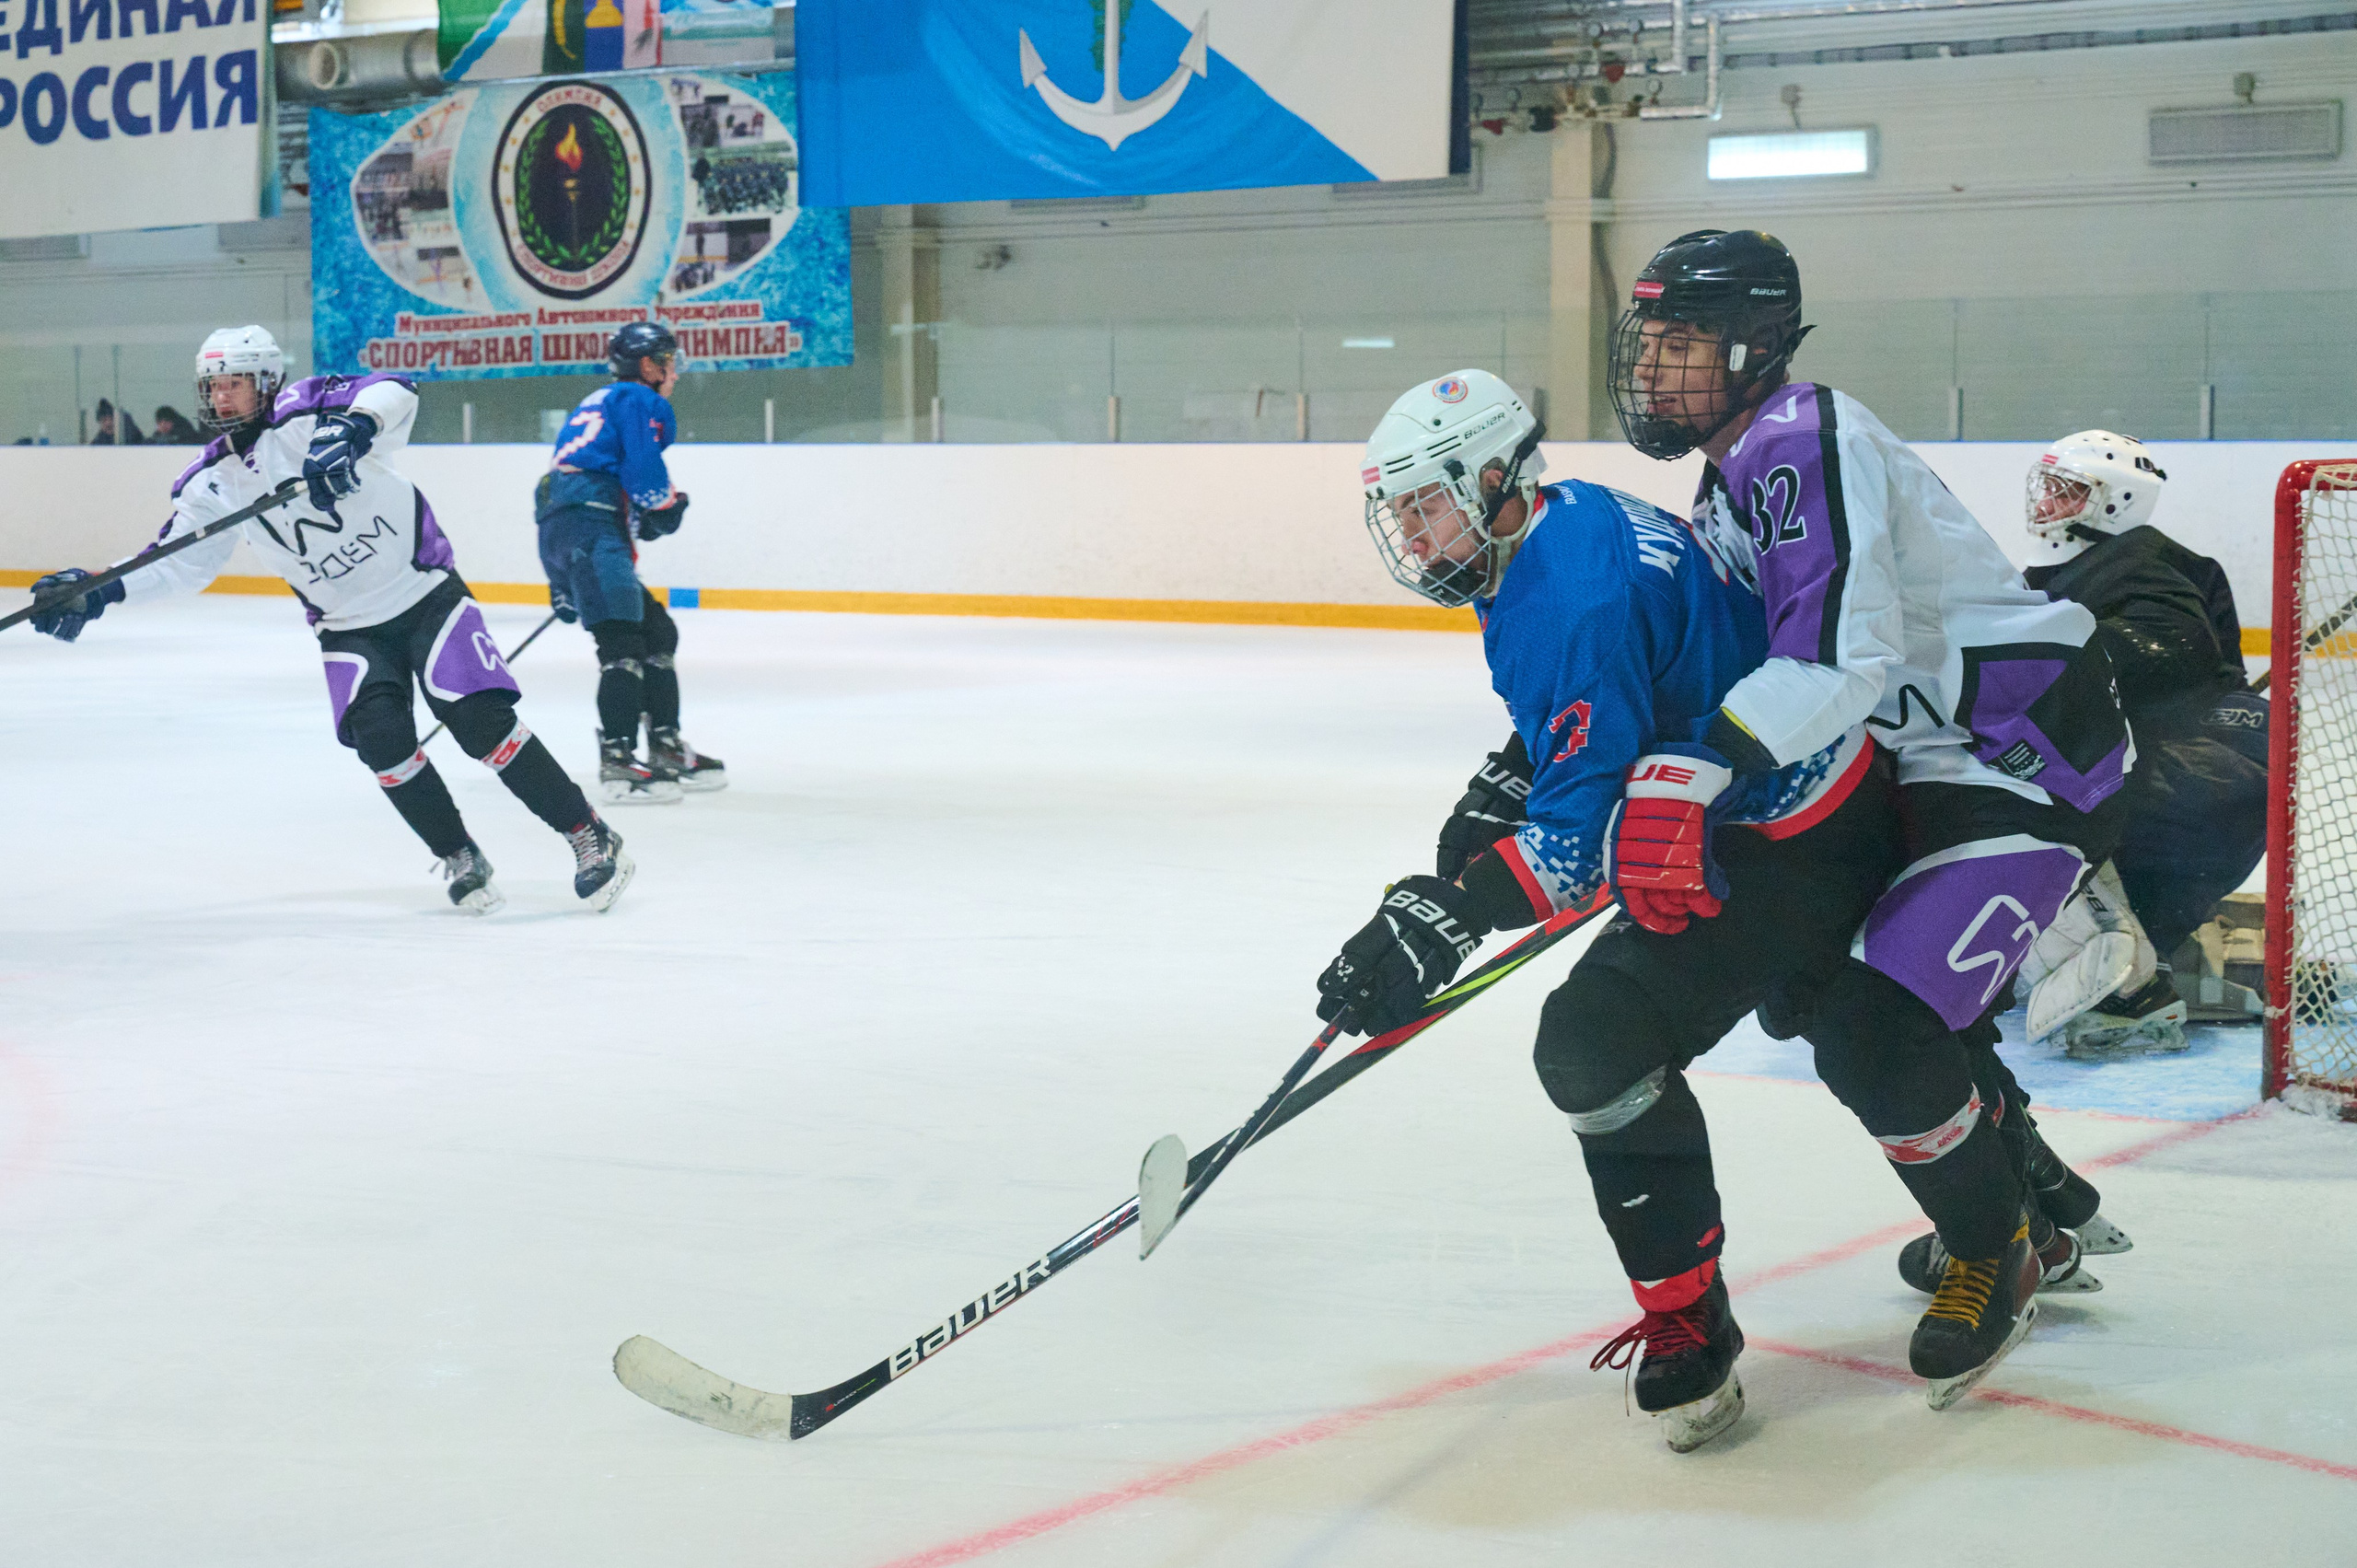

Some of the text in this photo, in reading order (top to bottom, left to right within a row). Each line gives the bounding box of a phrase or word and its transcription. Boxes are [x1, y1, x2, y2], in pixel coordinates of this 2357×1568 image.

[0, 0, 257, 59] ДИН
[1749, 287, 1787, 296] BAUER
[541, 331, 610, 362] ШКО
[675, 325, 799, 357] ЛИМПИЯ»
[1464, 412, 1506, 440] BAUER
[1751, 464, 1808, 557] 32
[1478, 758, 1533, 801] UE
[1626, 763, 1697, 786] UE
[1384, 889, 1477, 962] BAUE
[888, 1254, 1051, 1381] BAUER
